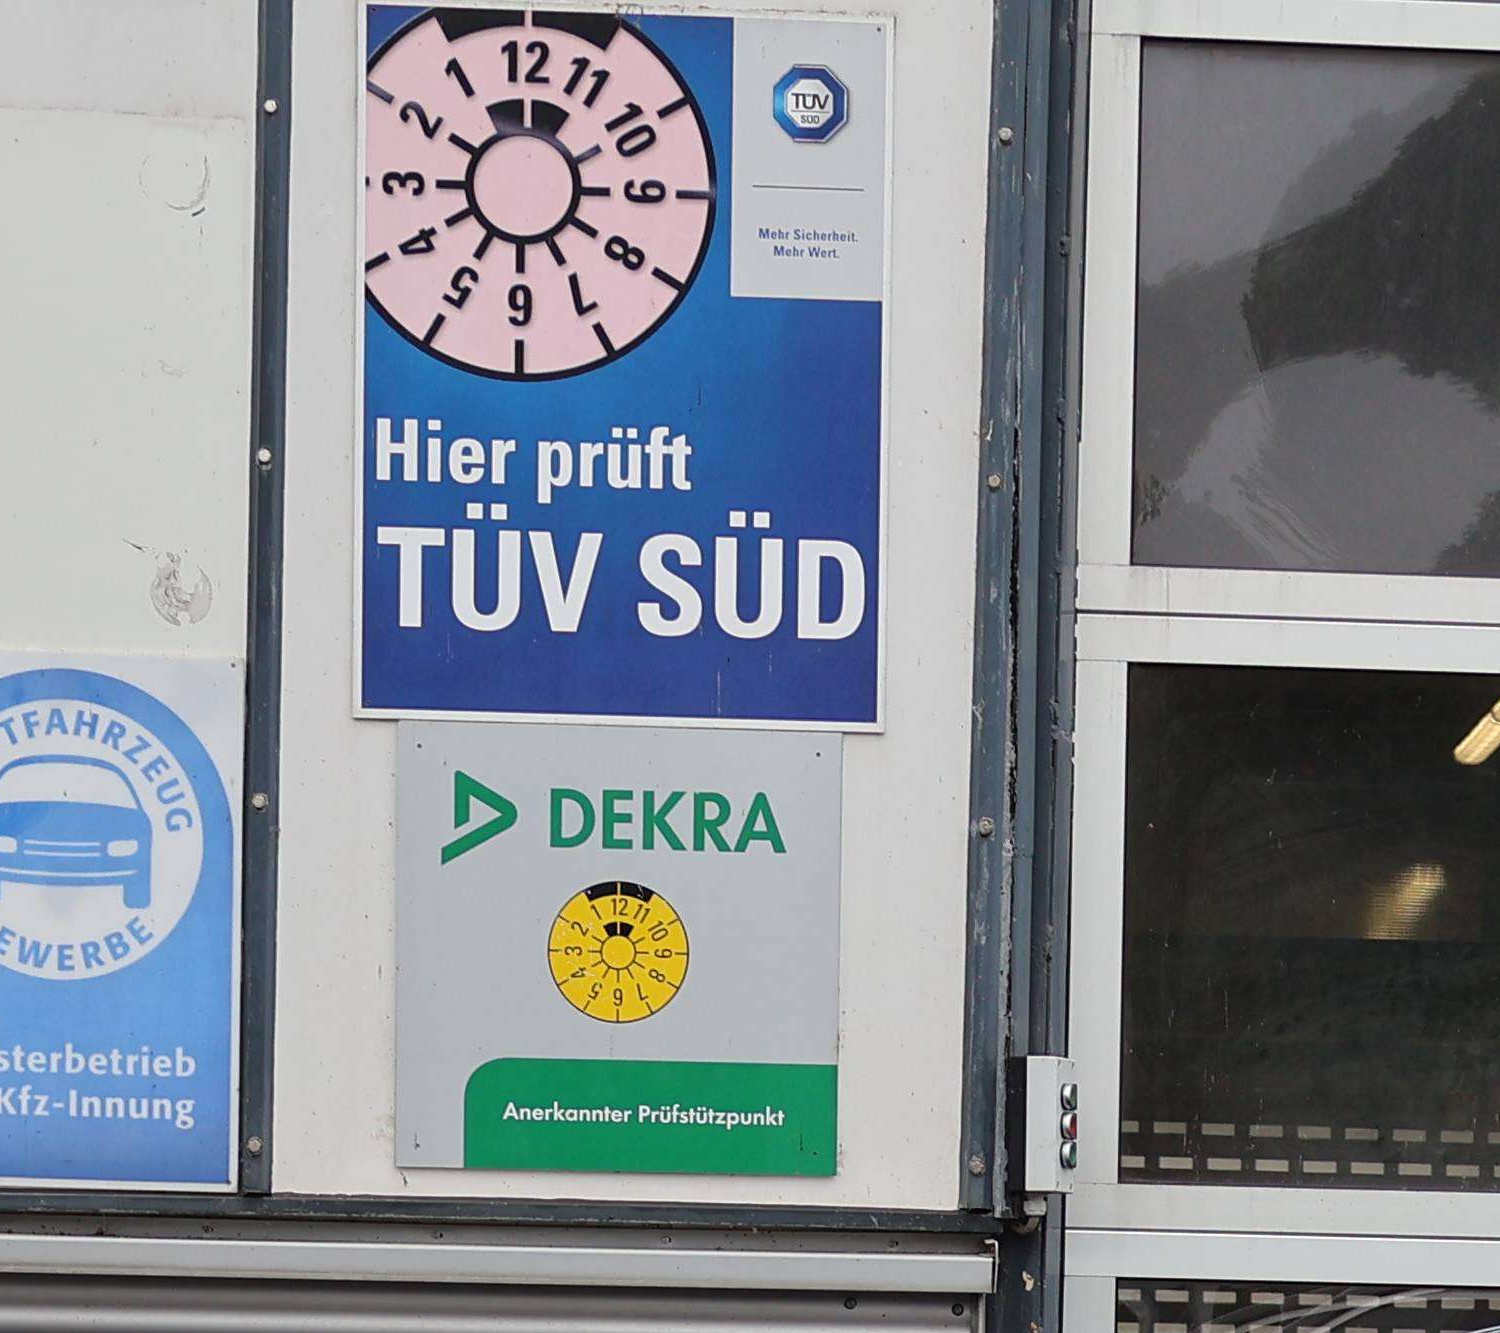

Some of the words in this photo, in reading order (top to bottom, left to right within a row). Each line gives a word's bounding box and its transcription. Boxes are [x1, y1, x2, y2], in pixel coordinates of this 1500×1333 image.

[500, 41, 550, 84] 12
[444, 57, 475, 98] 1
[563, 56, 610, 106] 11
[791, 92, 830, 110] TÜV
[399, 100, 444, 139] 2
[604, 102, 657, 157] 10
[801, 113, 820, 125] SÜD
[382, 171, 426, 197] 3
[623, 179, 667, 203] 9
[399, 226, 438, 257] 4
[758, 228, 789, 241] Mehr
[793, 228, 859, 243] Sicherheit.
[604, 234, 646, 270] 8
[773, 245, 804, 258] Mehr
[807, 246, 840, 259] Wert.
[442, 266, 480, 310] 5
[569, 272, 599, 317] 7
[508, 284, 533, 328] 6
[375, 417, 516, 486] Hier
[537, 425, 693, 504] prüft
[377, 502, 603, 633] TÜV
[636, 510, 866, 640] SÜD
[549, 787, 787, 854] DEKRA
[590, 904, 602, 920] 1
[611, 898, 629, 917] 12
[633, 904, 651, 924] 11
[571, 921, 589, 937] 2
[648, 920, 669, 942] 10
[564, 946, 583, 957] 3
[654, 948, 673, 959] 9
[570, 967, 587, 979] 4
[648, 969, 666, 983] 8
[588, 982, 603, 1001] 5
[613, 988, 623, 1007] 6
[636, 983, 649, 1001] 7
[503, 1102, 632, 1125] Anerkannter
[638, 1104, 785, 1130] Prüfstützpunkt
